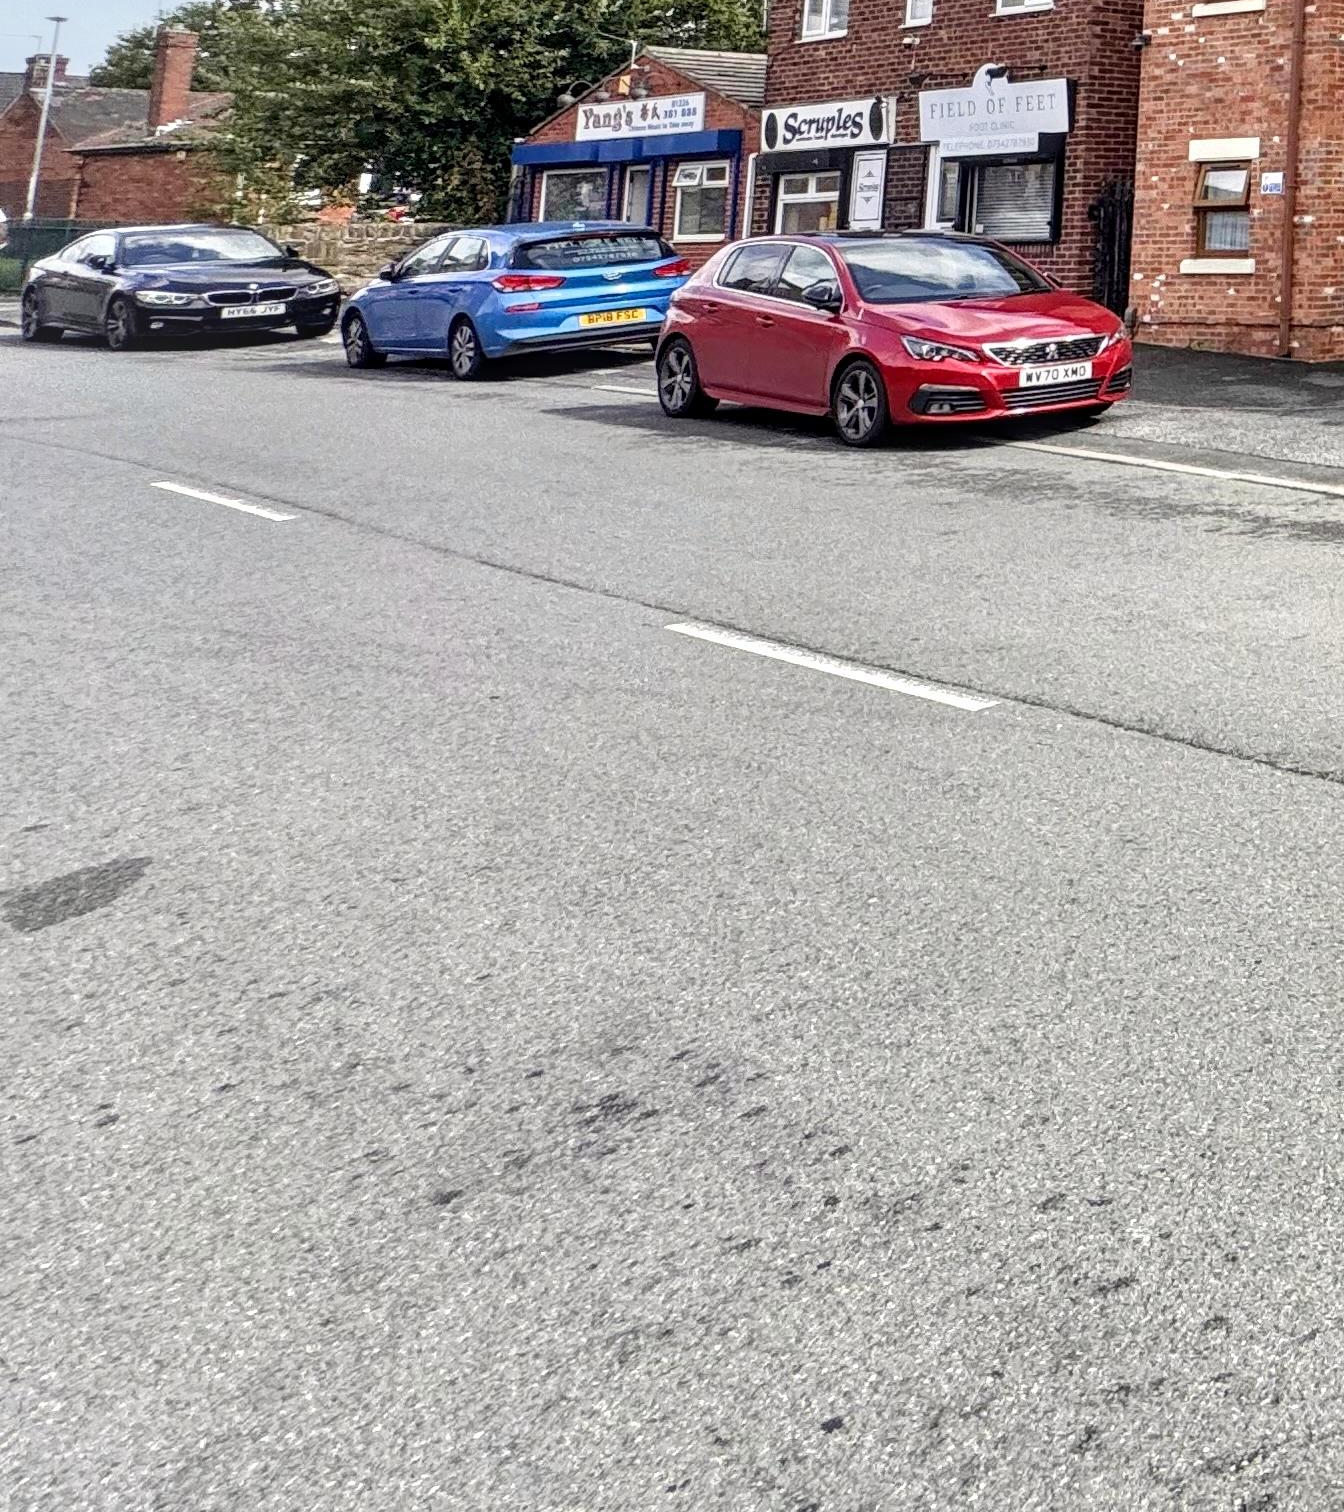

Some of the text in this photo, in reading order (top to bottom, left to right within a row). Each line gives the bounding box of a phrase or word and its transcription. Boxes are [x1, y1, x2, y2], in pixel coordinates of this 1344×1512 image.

[582, 104, 633, 131] Yang's
[930, 94, 1056, 119] FIELD OF FEET
[783, 107, 863, 145] Scruples
[1026, 365, 1086, 383] WV70 XMO
